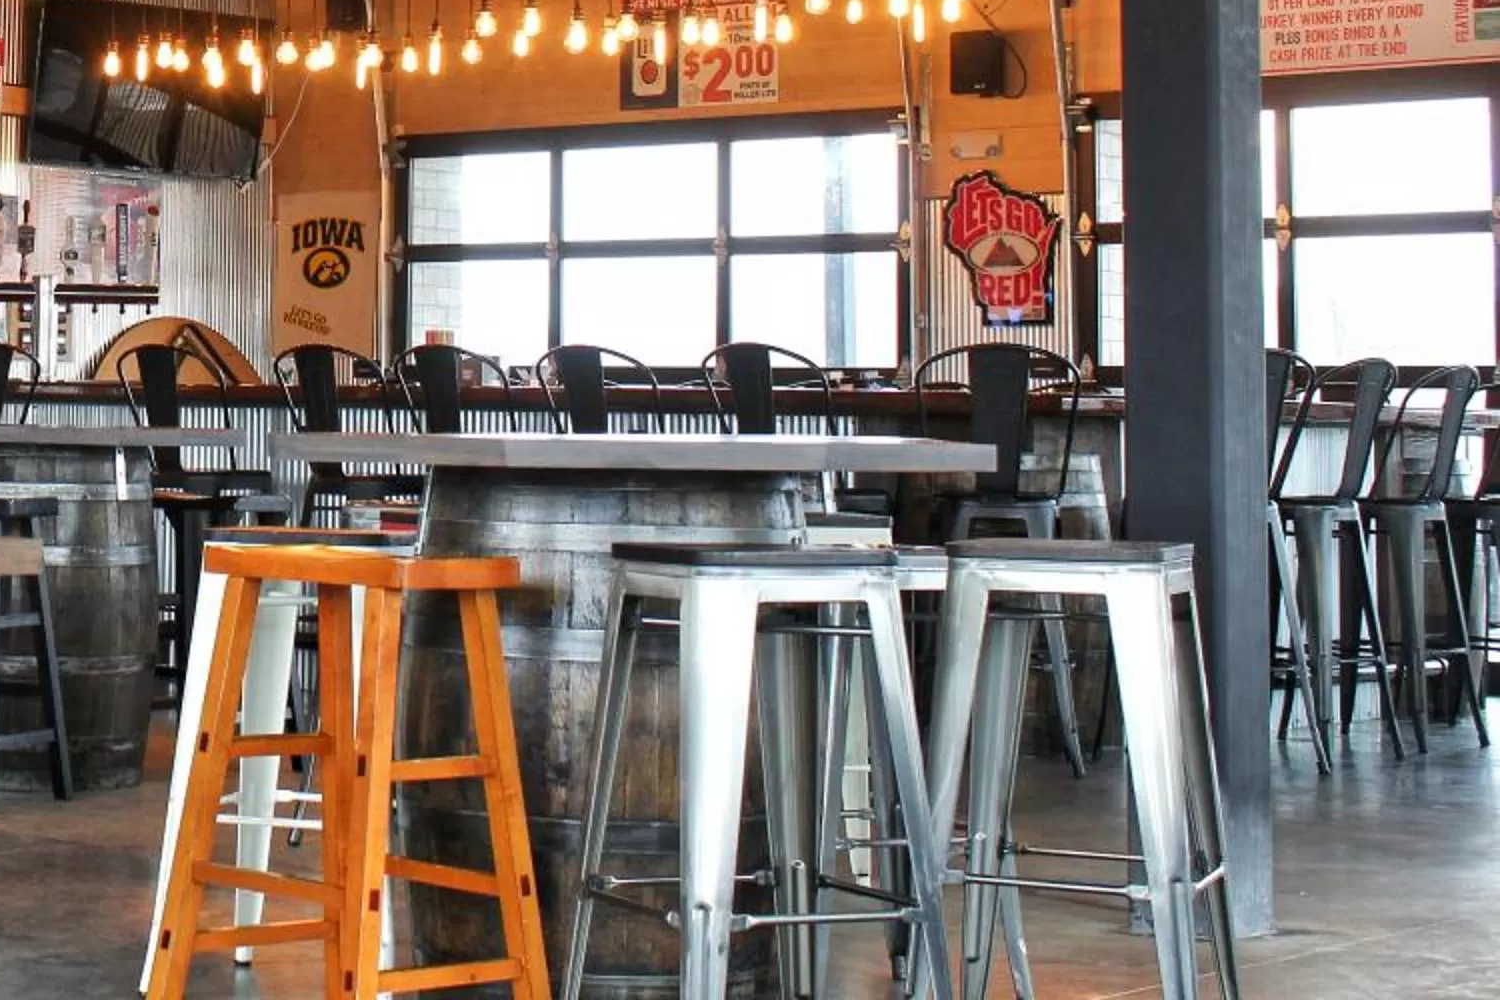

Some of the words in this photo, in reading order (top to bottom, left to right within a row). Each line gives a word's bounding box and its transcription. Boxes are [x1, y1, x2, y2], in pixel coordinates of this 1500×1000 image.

[1260, 12, 1294, 28] URKEY
[1299, 8, 1343, 25] WINNER
[1347, 4, 1383, 21] EVERY
[1275, 30, 1301, 45] PLUS
[1305, 26, 1339, 42] BONUS
[1343, 24, 1375, 41] BINGO
[1379, 24, 1388, 38] &
[1393, 22, 1402, 37] A
[1269, 47, 1298, 62] CASH
[1301, 44, 1333, 61] PRIZE
[1337, 42, 1351, 58] AT
[1358, 42, 1378, 57] THE
[733, 90, 760, 99] MILLER
[292, 218, 365, 254] IOWA
